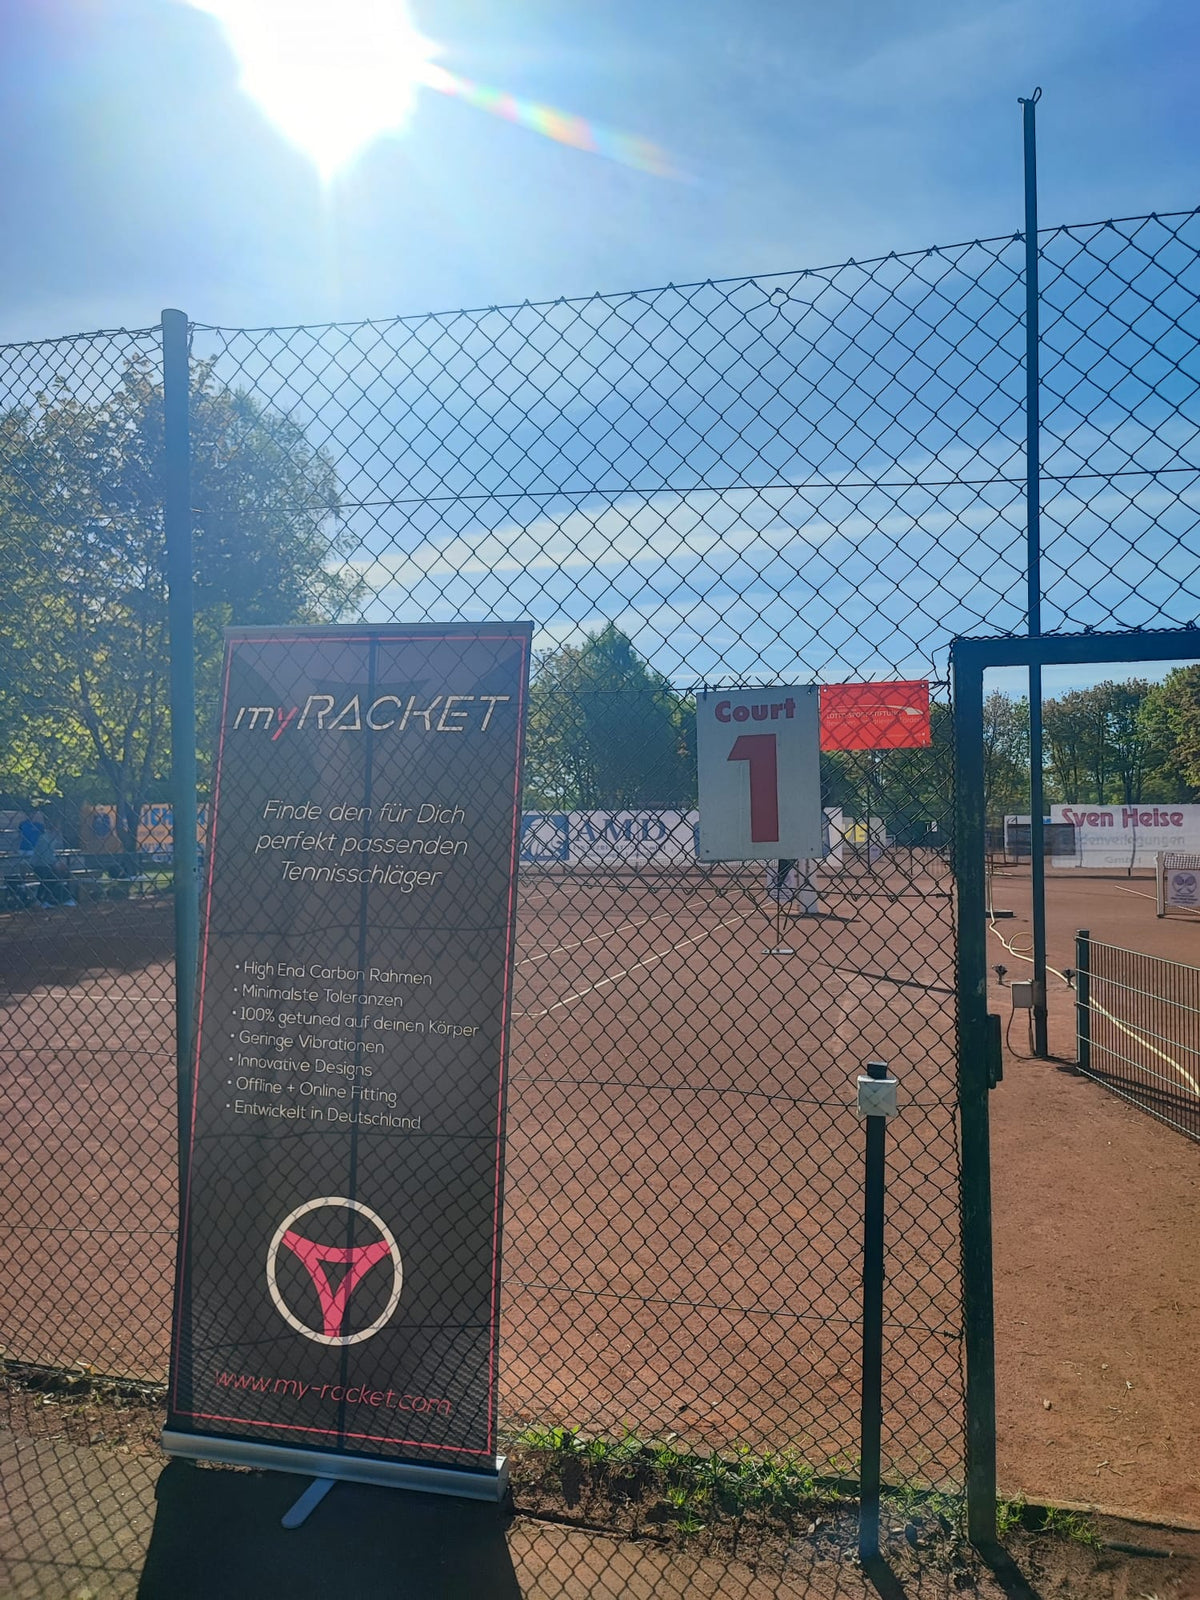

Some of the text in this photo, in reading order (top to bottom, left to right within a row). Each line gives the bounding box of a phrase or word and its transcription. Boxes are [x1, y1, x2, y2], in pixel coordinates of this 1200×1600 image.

[232, 694, 510, 741] myRACKET
[714, 697, 796, 724] Court
[727, 733, 780, 843] 1
[263, 800, 465, 824] Finde den für Dich
[1061, 807, 1184, 829] Sven Heise
[255, 831, 469, 856] perfekt passenden
[575, 818, 666, 842] AMD
[281, 860, 443, 893] Tennisschläger
[244, 961, 432, 985] High End Carbon Rahmen
[242, 983, 403, 1007] Minimalste Toleranzen
[240, 1007, 479, 1039] 100% getuned auf deinen Körper
[239, 1029, 385, 1054] Geringe Vibrationen
[237, 1053, 373, 1080] Innovative Designs
[236, 1076, 398, 1108] Offline + Online Fitting
[234, 1100, 422, 1130] Entwickelt in Deutschland
[214, 1370, 452, 1416] www.my-racket.com
